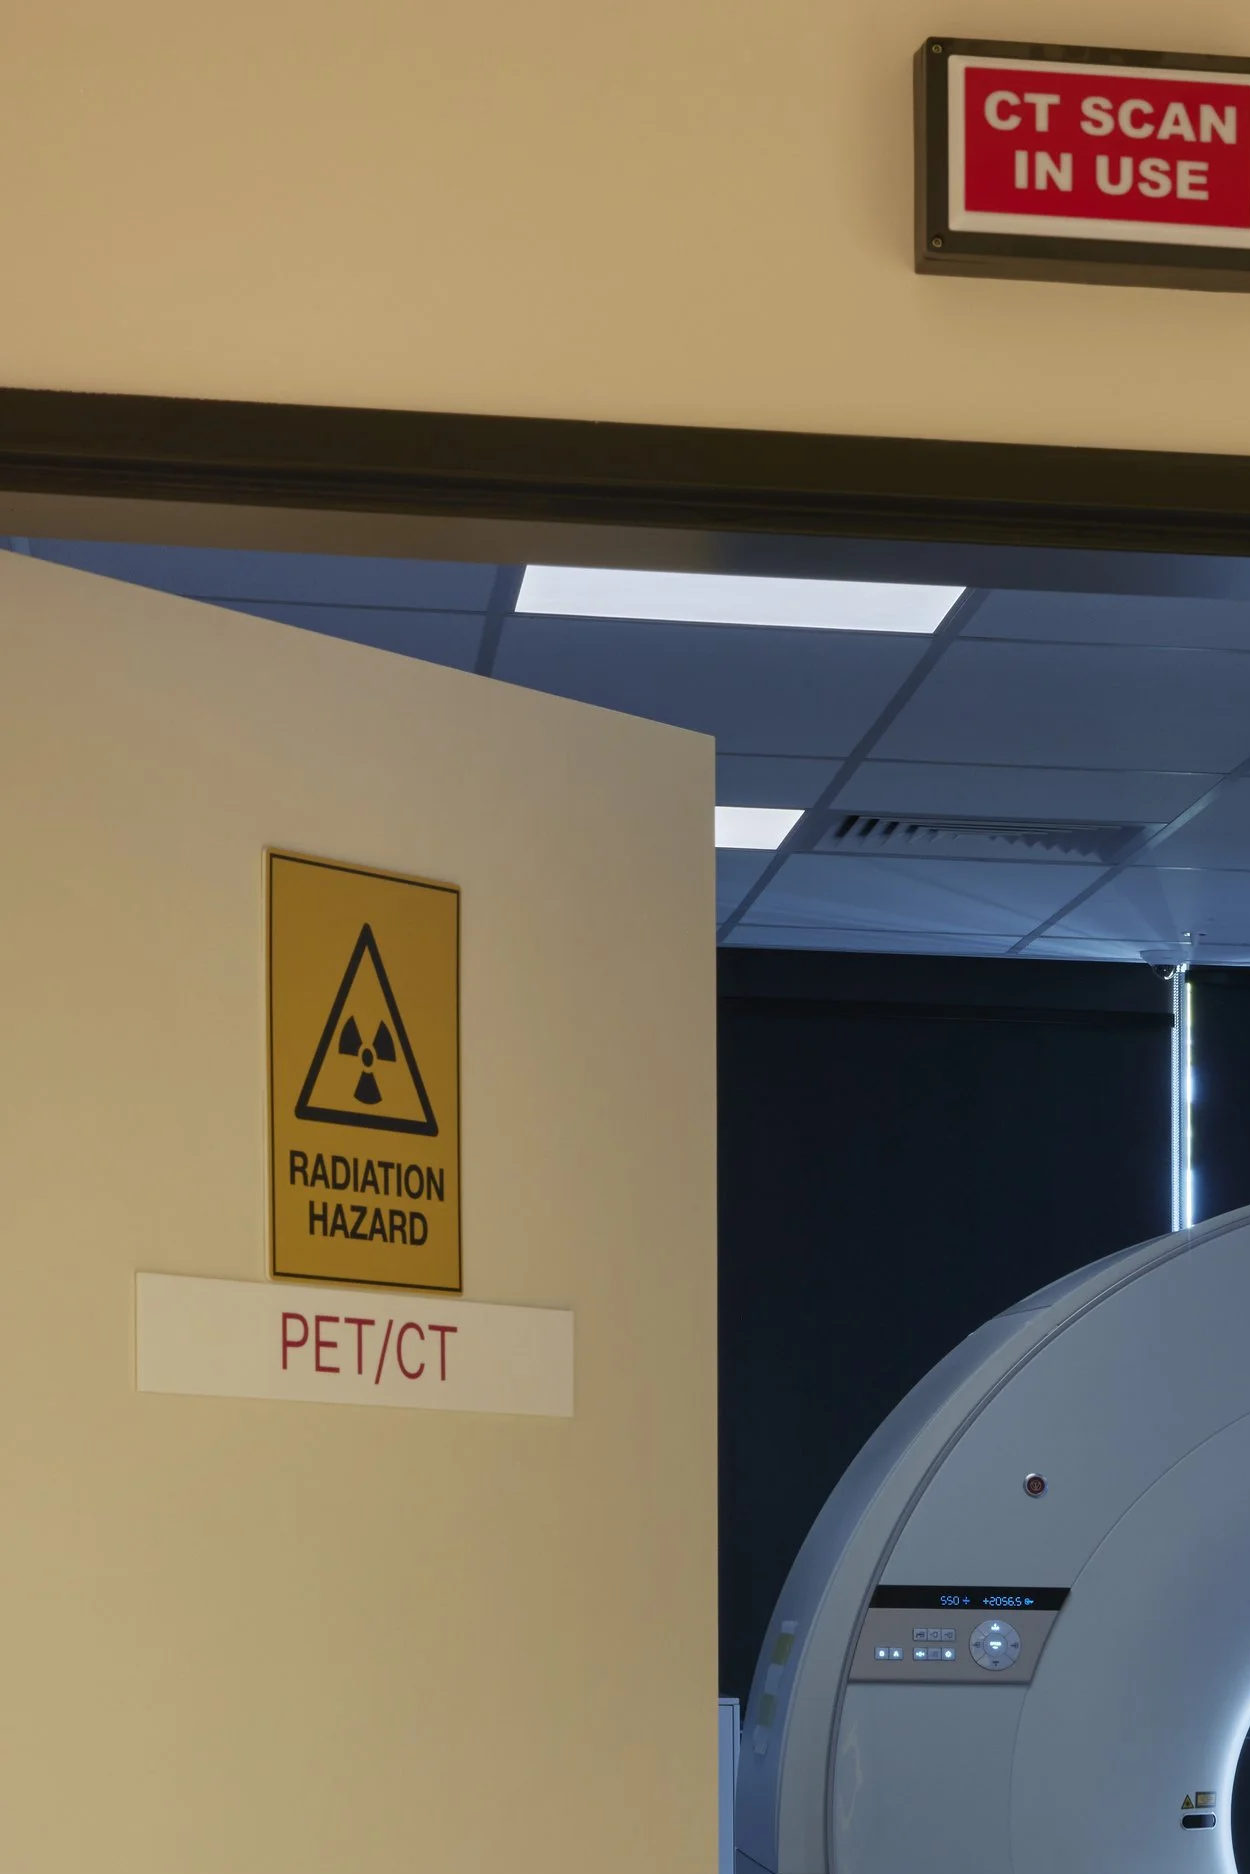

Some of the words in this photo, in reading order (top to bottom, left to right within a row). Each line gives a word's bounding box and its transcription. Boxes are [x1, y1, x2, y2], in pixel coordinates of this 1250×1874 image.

[984, 90, 1061, 132] CT
[1080, 97, 1237, 145] SCAN
[1014, 150, 1073, 192] IN
[1095, 154, 1209, 200] USE
[289, 1150, 445, 1202] RADIATION
[308, 1201, 429, 1246] HAZARD
[280, 1311, 458, 1385] PET/CT
